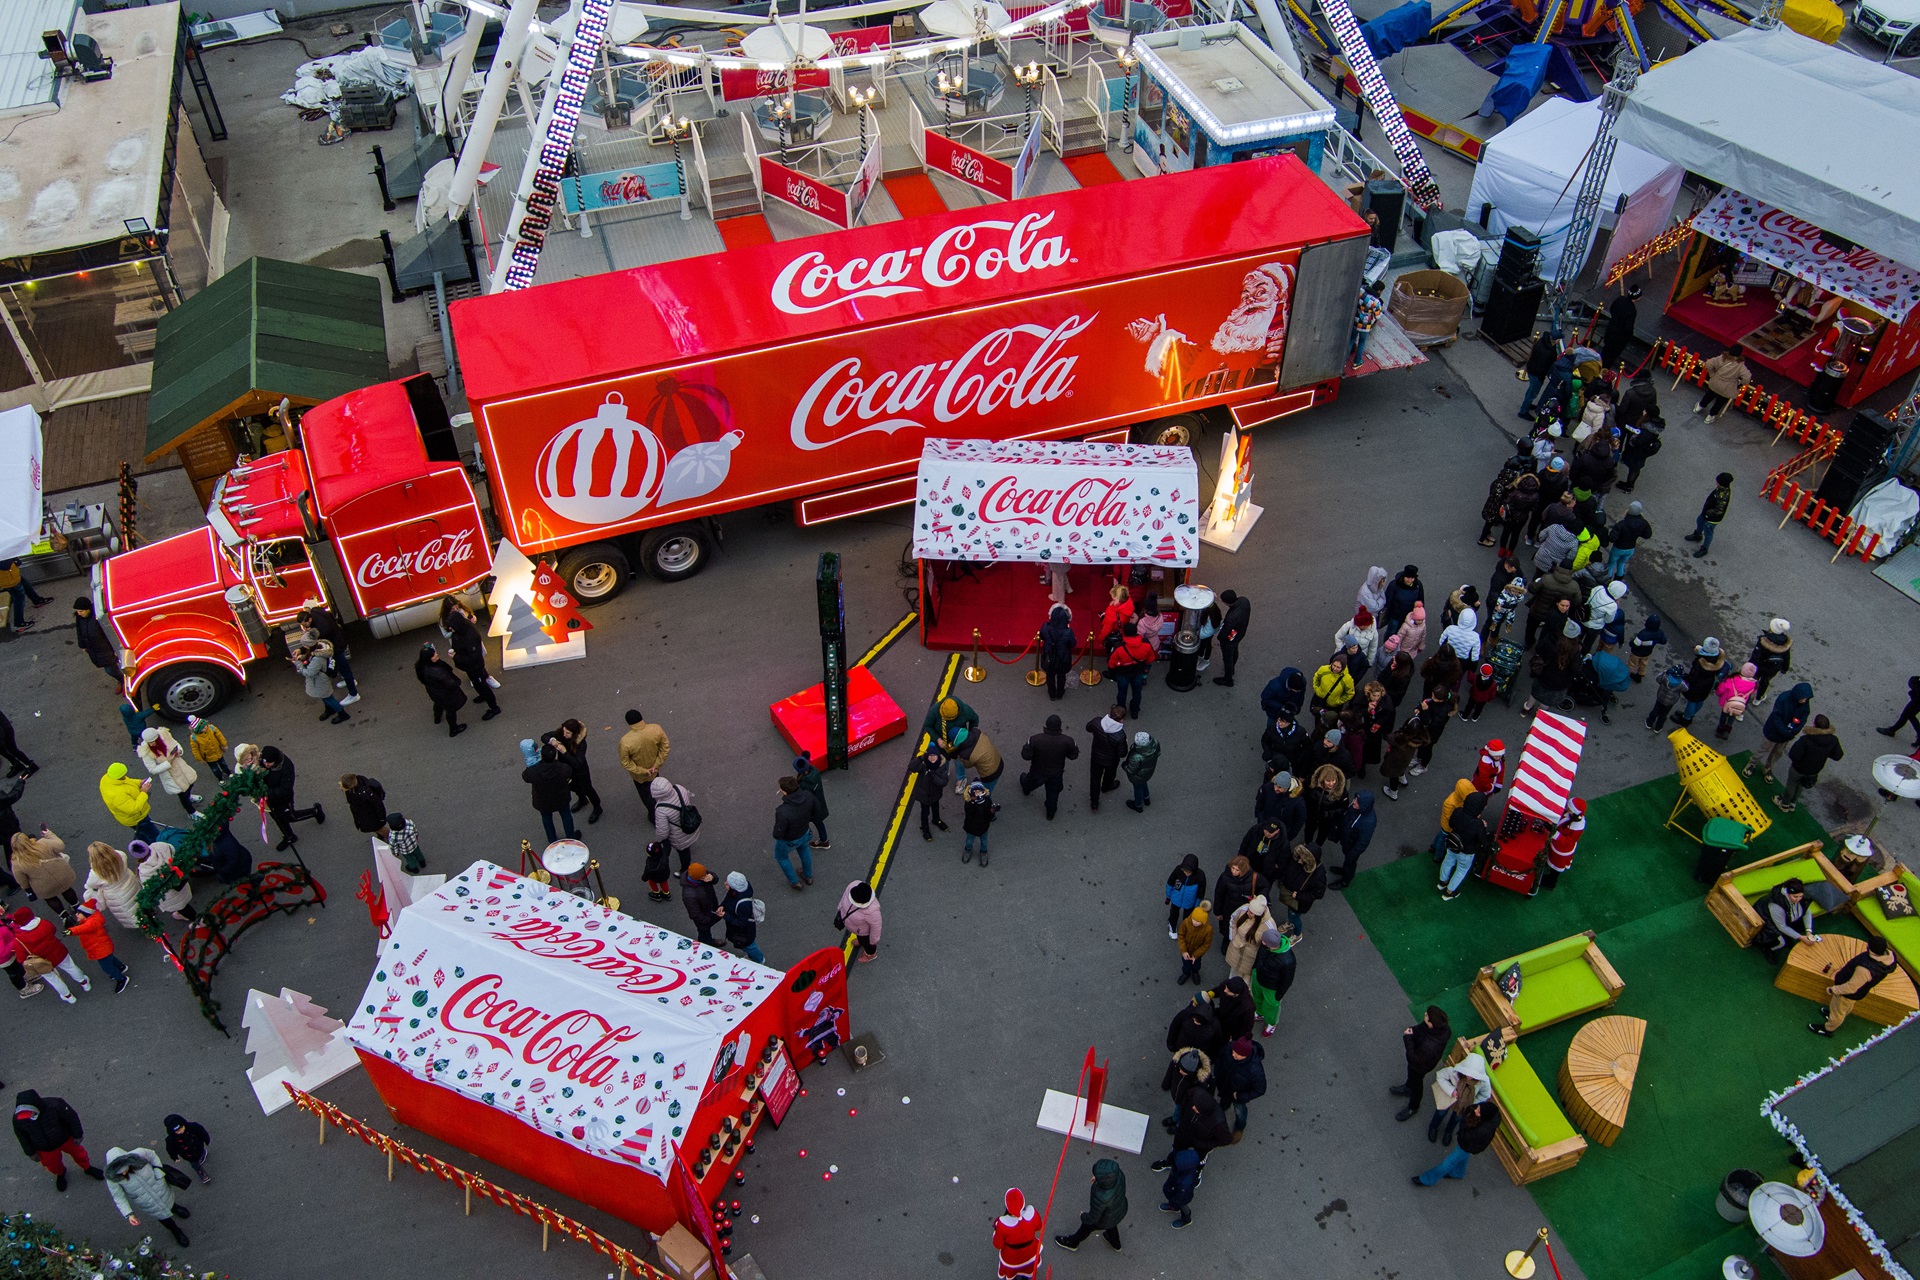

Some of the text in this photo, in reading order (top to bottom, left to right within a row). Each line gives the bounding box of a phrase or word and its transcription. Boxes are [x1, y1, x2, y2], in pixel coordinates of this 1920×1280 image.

[771, 209, 1071, 315] Coca-Cola
[1758, 208, 1880, 271] CocaCola
[790, 310, 1101, 451] Coca-Cola
[978, 475, 1136, 527] Coca-Cola
[357, 527, 476, 588] Coca-Cola
[483, 917, 688, 995] Coca-Cola
[440, 973, 643, 1088] Coca-Cola
